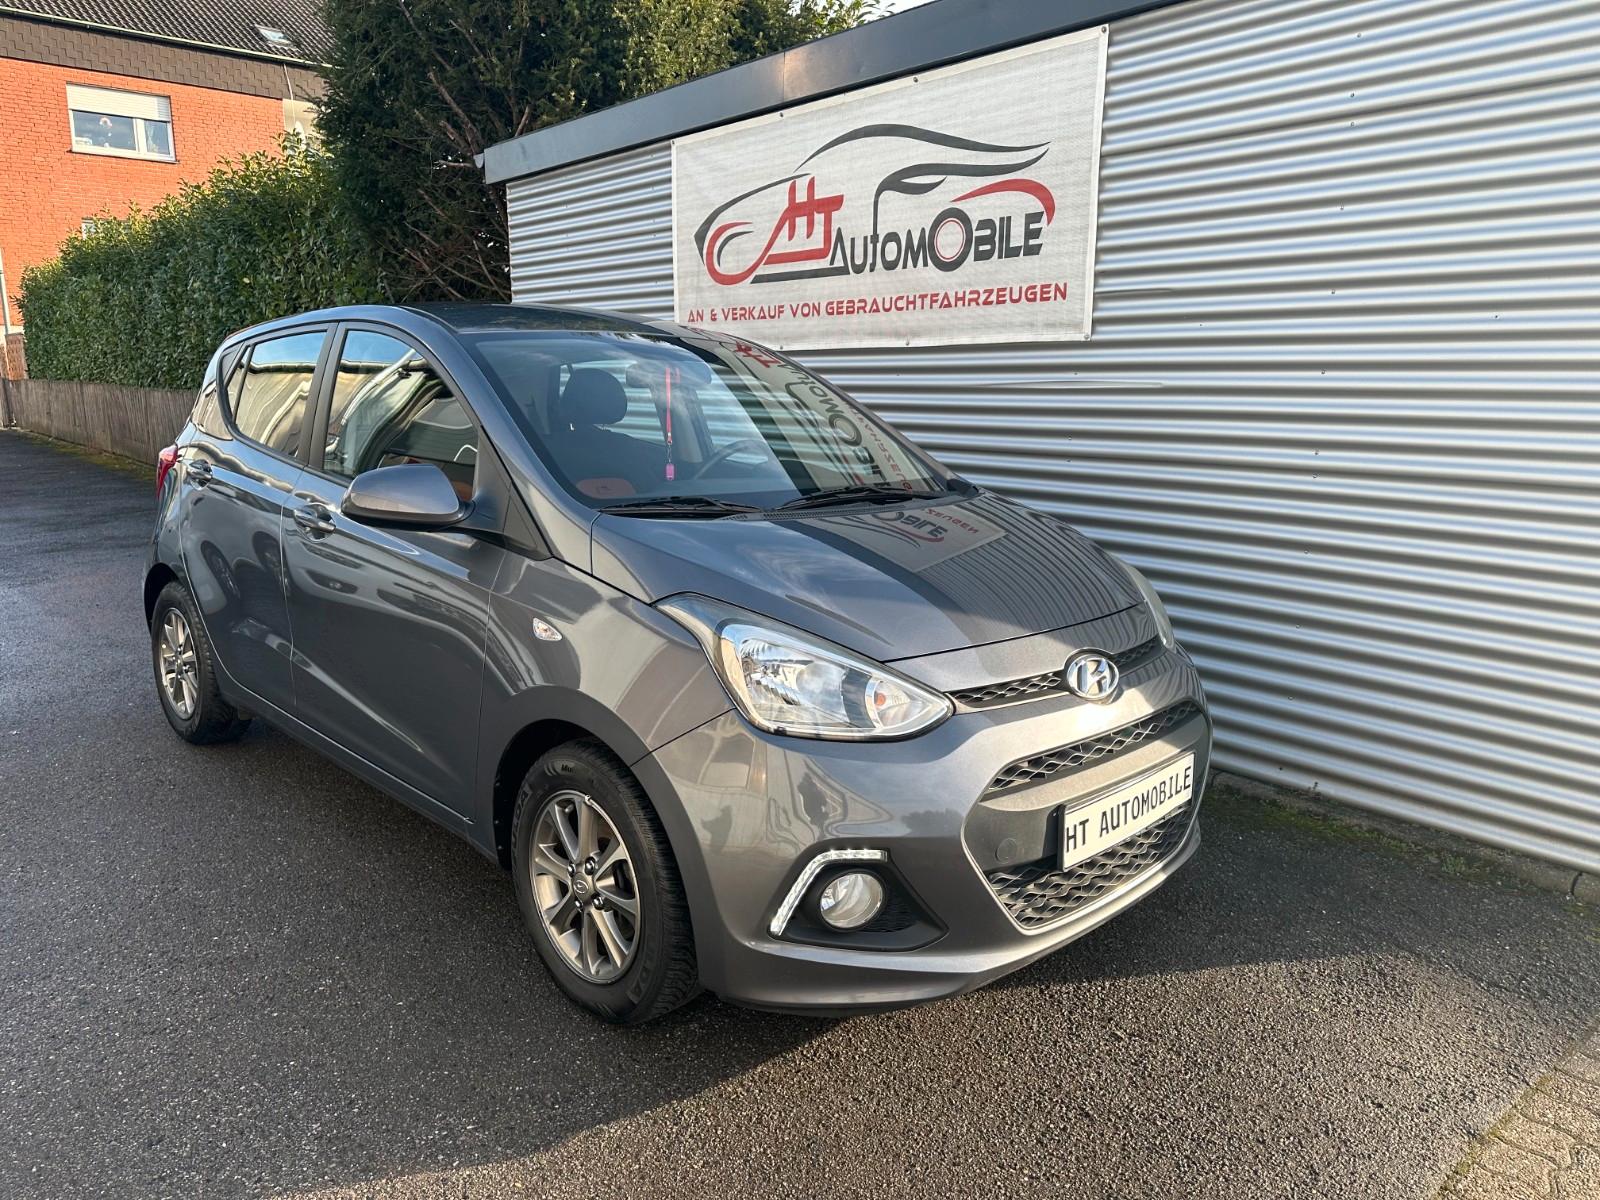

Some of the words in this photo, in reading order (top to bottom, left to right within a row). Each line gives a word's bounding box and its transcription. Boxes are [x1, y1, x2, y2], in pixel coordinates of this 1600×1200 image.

[828, 207, 1045, 274] AUTOMOBILE
[688, 309, 704, 323] AN
[711, 308, 718, 322] &
[721, 304, 785, 321] VERKAUF
[789, 302, 821, 318] VON
[825, 282, 1068, 316] GEBRAUCHTFAHRZEUGEN
[1066, 818, 1089, 852] HT
[1099, 766, 1192, 837] AUTOMOBILE
